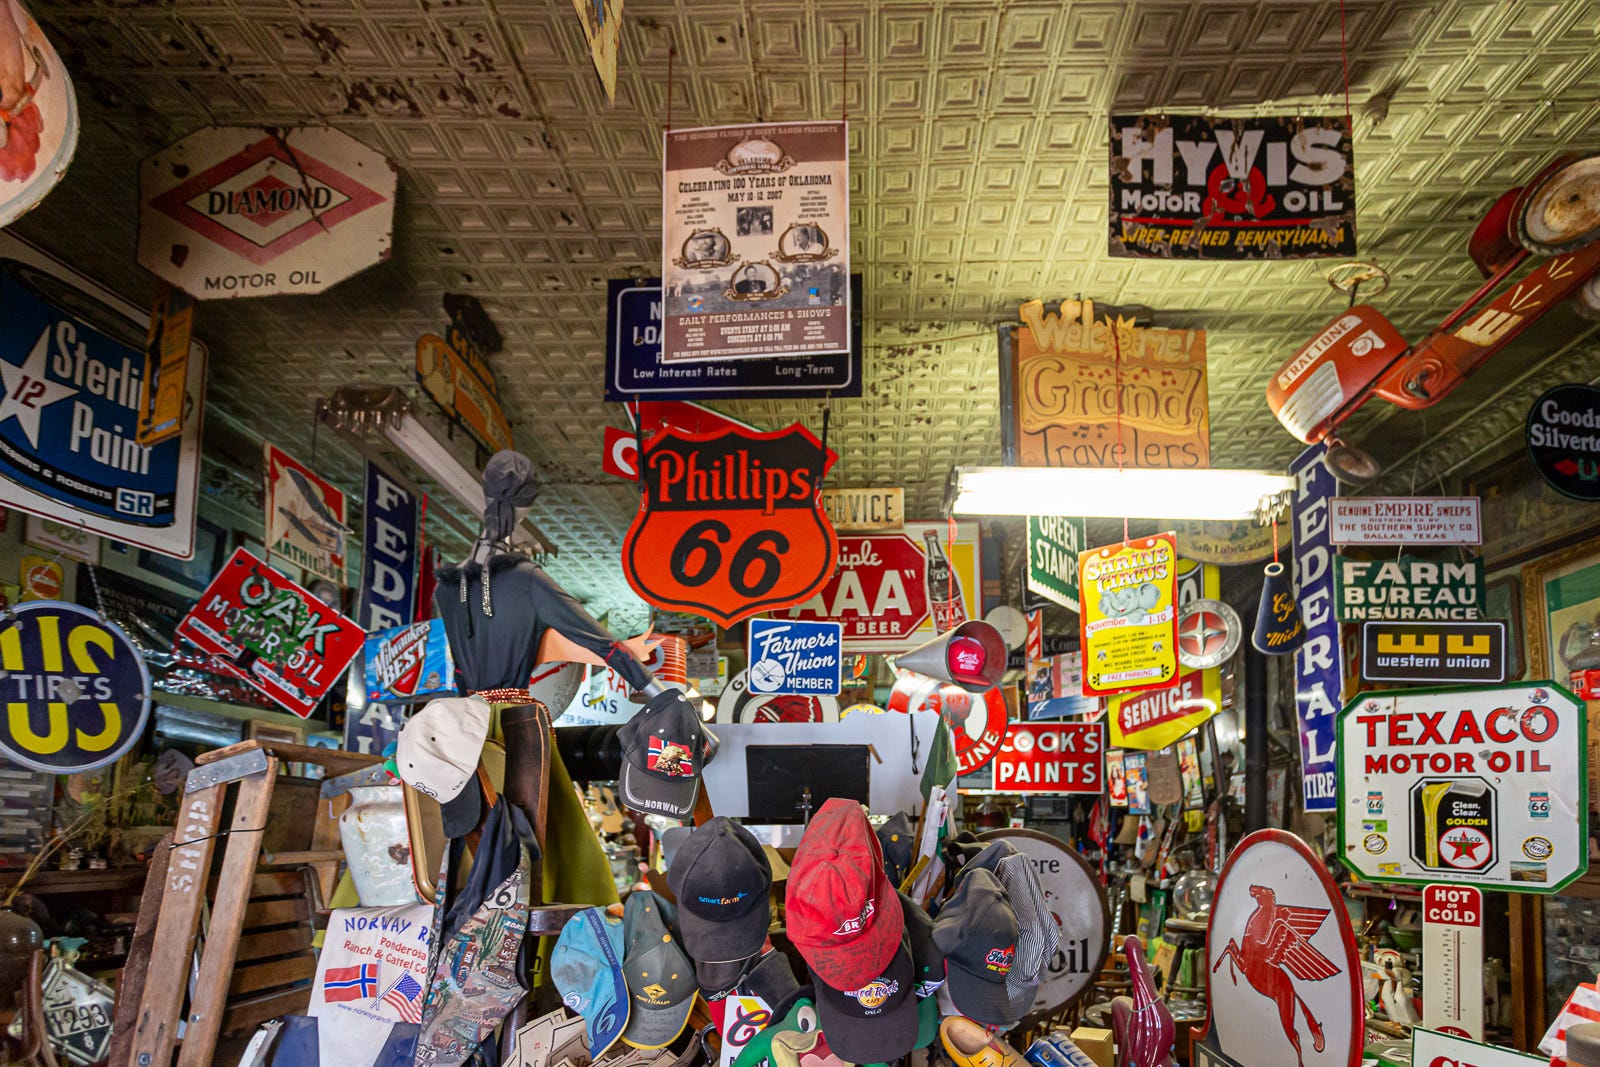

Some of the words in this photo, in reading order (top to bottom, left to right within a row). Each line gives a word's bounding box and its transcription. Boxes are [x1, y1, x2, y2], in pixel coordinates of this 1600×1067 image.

[1121, 127, 1346, 187] HYVIS
[679, 182, 730, 194] CELEBRATING
[733, 179, 745, 189] 100
[748, 177, 775, 188] YEARS
[778, 177, 787, 186] OF
[789, 175, 832, 186] OKLAHOMA
[208, 187, 332, 216] DIAMOND
[727, 193, 744, 203] MAY
[766, 190, 783, 201] 2007
[1121, 188, 1201, 213] MOTOR
[1283, 190, 1344, 213] OIL
[204, 272, 277, 291] MOTOR
[289, 270, 321, 286] OIL
[679, 317, 706, 326] DAILY
[709, 313, 785, 324] PERFORMANCES
[788, 311, 794, 319] &
[797, 309, 832, 318] SHOWS
[1282, 322, 1350, 382] TRACTONE
[633, 369, 654, 378] Low
[659, 367, 701, 378] Interest
[707, 368, 737, 377] Rates
[776, 365, 834, 377] Long-Term
[12, 375, 46, 409] 12
[1025, 359, 1202, 425] Grand
[70, 401, 153, 475] Paint
[1024, 425, 1199, 468] Travelers
[56, 475, 112, 500] ROBERTS
[648, 449, 811, 516] Phillips
[120, 492, 153, 514] SR
[822, 493, 894, 524] ERVICE
[1338, 506, 1372, 516] GENUINE
[1375, 503, 1434, 516] EMPIRE
[1436, 506, 1471, 516] SWEEPS
[1038, 513, 1078, 553] GREEN
[1361, 523, 1413, 531] SOUTHERN
[1416, 523, 1455, 531] SUPPLY
[670, 519, 790, 598] 66
[1087, 546, 1169, 583] SHRINE
[1097, 563, 1169, 593] CIRCUS
[1343, 562, 1476, 585] FARM
[1344, 587, 1477, 605] BUREAU
[240, 576, 342, 655] OAK
[1297, 452, 1336, 766] FEDERAL
[1344, 607, 1478, 620] INSURANCE
[856, 621, 900, 634] BEER
[1087, 617, 1127, 632] November
[206, 594, 280, 655] MOTOR
[287, 649, 324, 686] OIL
[754, 626, 837, 662] Farmers
[384, 633, 427, 690] BEST
[778, 650, 836, 676] Union
[1377, 656, 1440, 668] western
[1446, 655, 1490, 668] union
[787, 678, 833, 690] MEMBER
[1124, 670, 1153, 679] PARKING
[11, 673, 113, 701] TIRES
[1124, 681, 1194, 729] SERVICE
[1356, 705, 1559, 748] TEXACO
[1000, 728, 1099, 753] COOK'S
[1000, 761, 1096, 783] PAINTS
[1364, 752, 1476, 775] MOTOR
[1486, 750, 1551, 773] OIL
[644, 799, 680, 814] NORWAY
[1368, 800, 1382, 809] 66
[1452, 801, 1480, 809] Clean.
[1532, 802, 1548, 812] 66
[1446, 818, 1488, 826] GOLDEN
[170, 800, 210, 893] SHOP
[698, 895, 740, 905] smartfarm
[1434, 890, 1471, 903] HOT
[345, 916, 412, 935] NORWAY
[1429, 908, 1476, 923] COLD
[344, 940, 373, 955] Ranch
[374, 950, 383, 959] &
[380, 936, 427, 961] Ponderosa
[636, 994, 671, 1005] AUSTRALIA
[874, 979, 899, 998] Rock
[51, 1003, 108, 1034] 1293
[83, 1032, 94, 1048] 8
